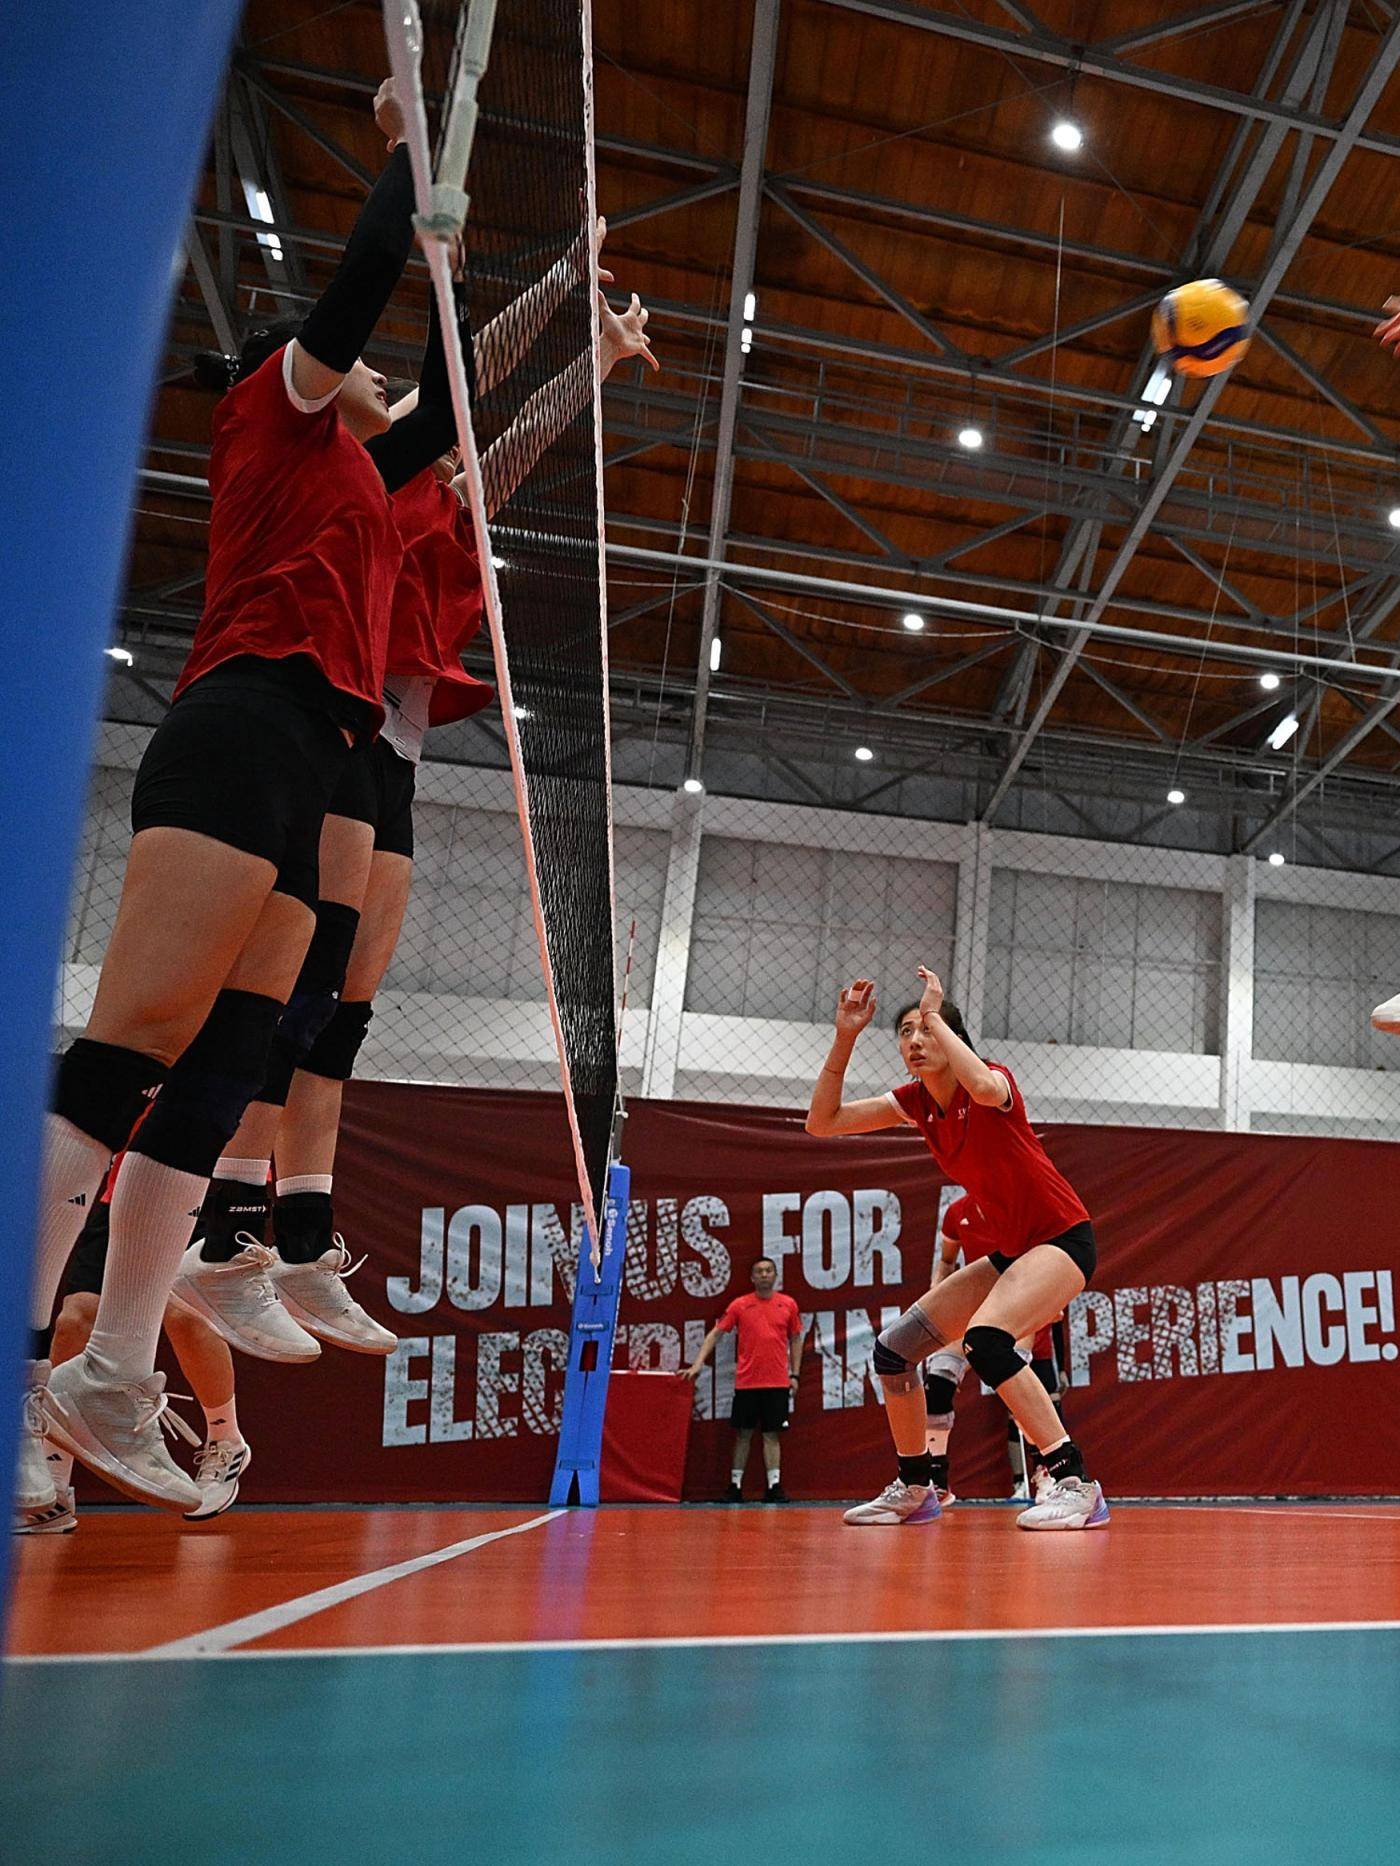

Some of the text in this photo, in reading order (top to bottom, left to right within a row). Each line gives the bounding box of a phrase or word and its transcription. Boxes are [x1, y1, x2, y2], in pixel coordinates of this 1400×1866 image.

[387, 1202, 589, 1314] JOIN
[625, 1196, 732, 1301] US
[762, 1189, 902, 1291] FOR
